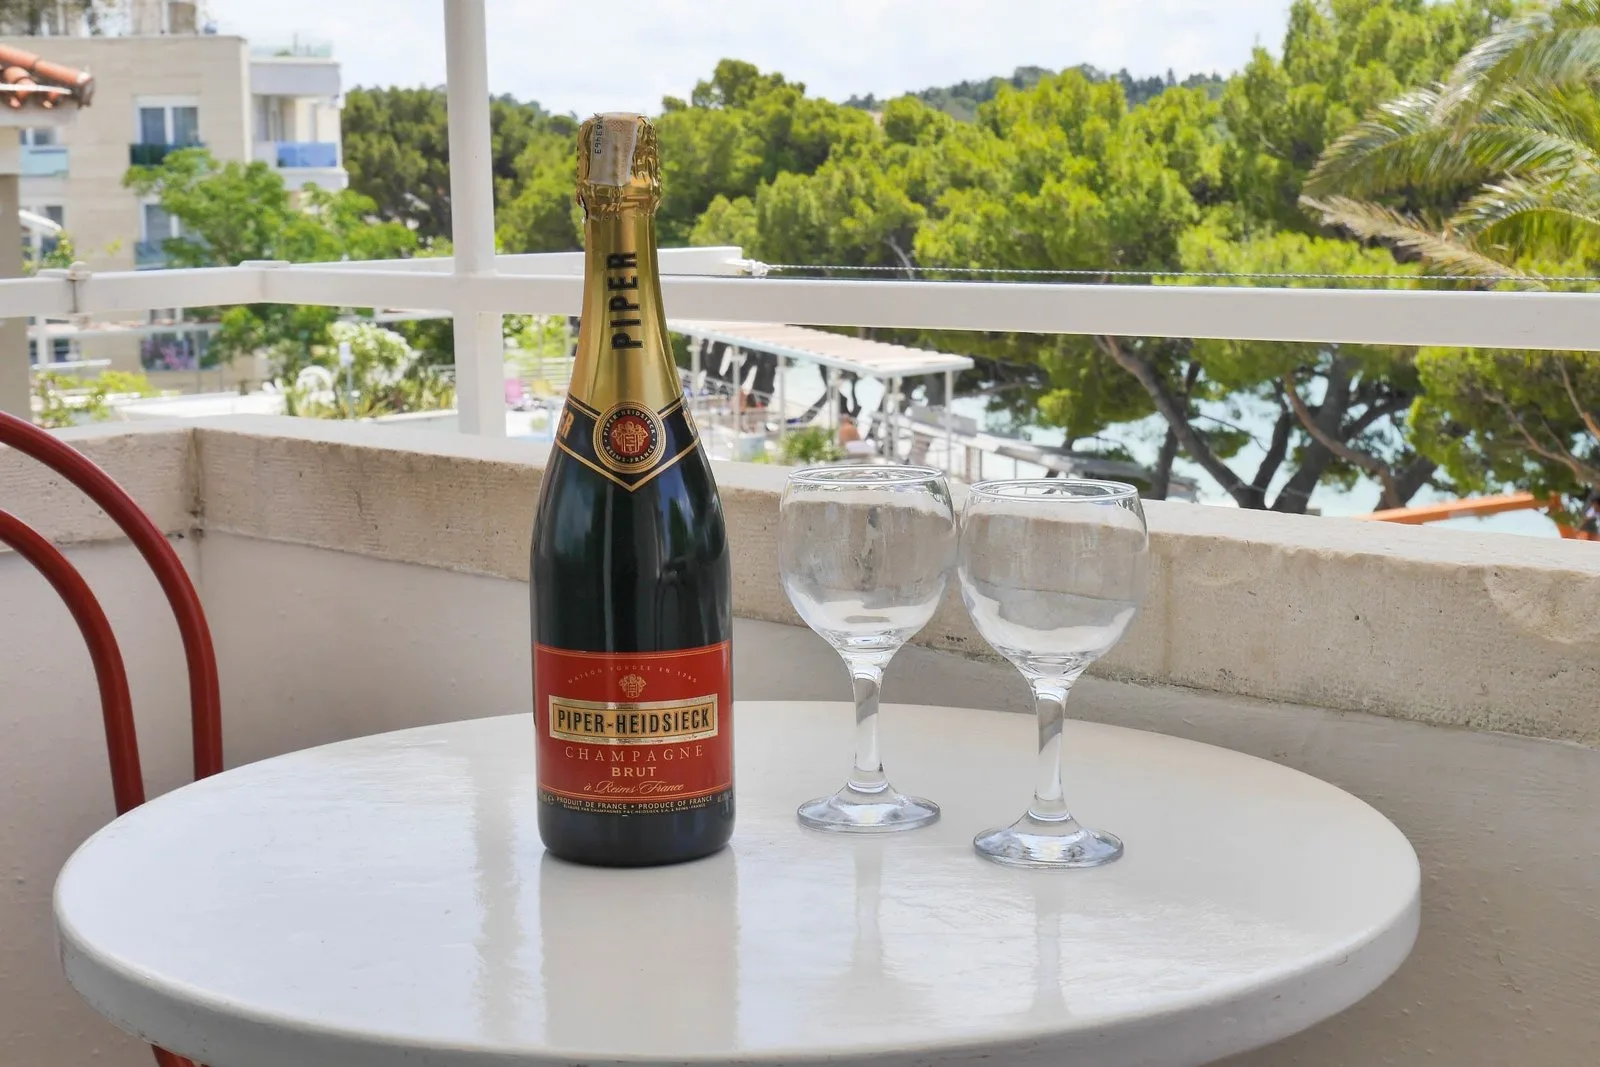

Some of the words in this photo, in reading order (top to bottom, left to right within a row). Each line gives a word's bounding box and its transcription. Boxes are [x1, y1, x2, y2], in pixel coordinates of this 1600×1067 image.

[607, 252, 643, 349] PIPER
[557, 707, 710, 734] PIPER-HEIDSIECK
[565, 745, 703, 762] CHAMPAGNE
[611, 766, 657, 777] BRUT
[556, 796, 582, 806] PRODUIT
[638, 801, 674, 809] PRODUCE
[689, 794, 712, 805] FRANCE
